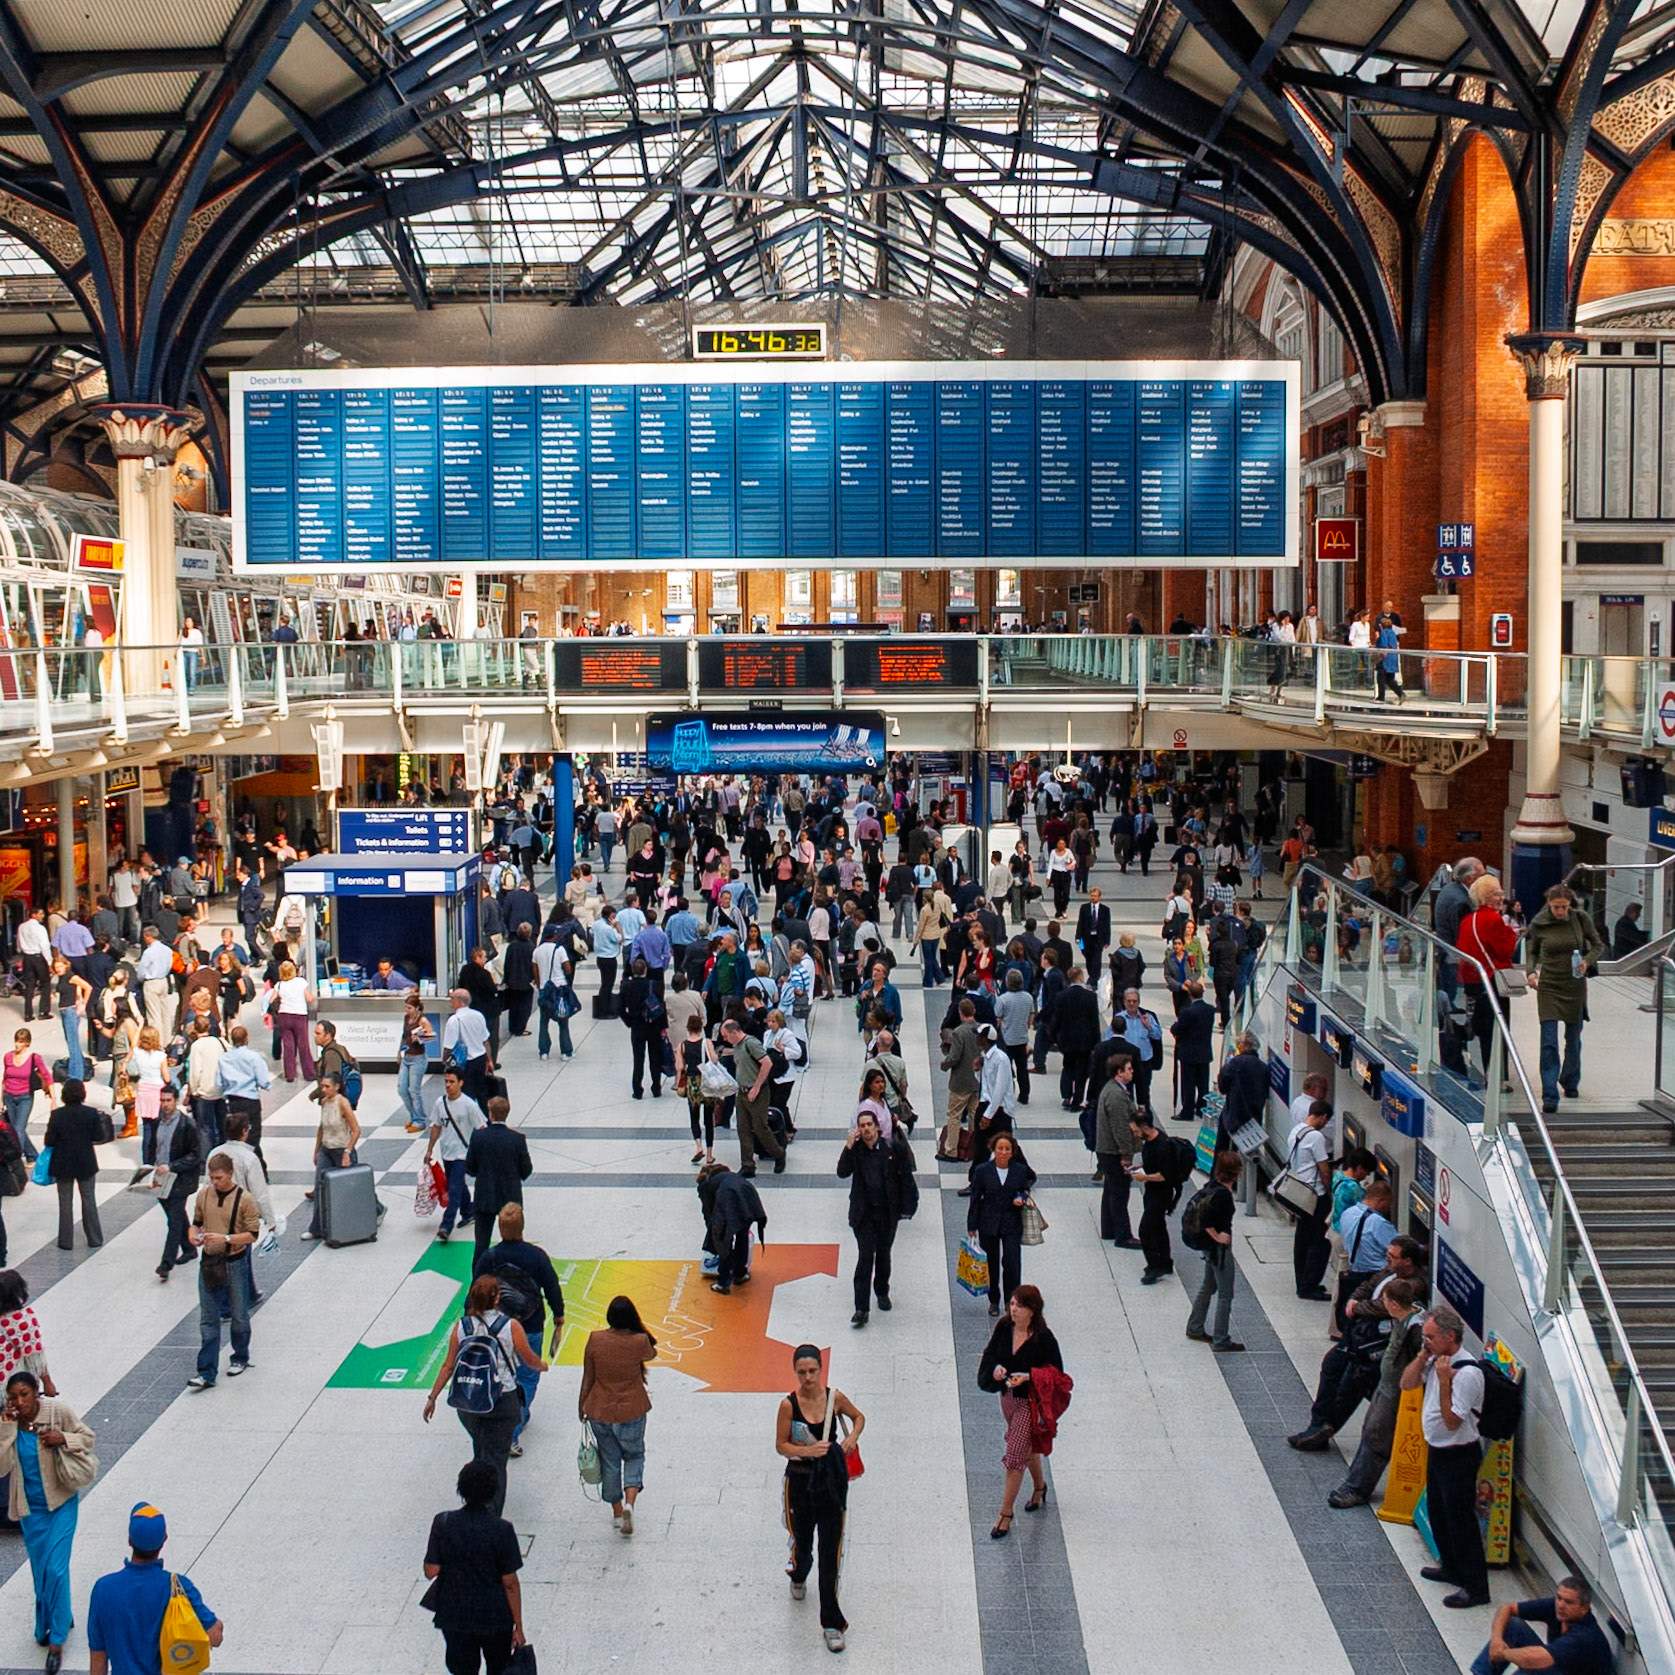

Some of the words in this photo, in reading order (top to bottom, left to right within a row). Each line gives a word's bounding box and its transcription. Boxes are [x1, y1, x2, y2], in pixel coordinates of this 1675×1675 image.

[250, 376, 302, 386] Departures
[712, 722, 728, 730] Free
[730, 722, 748, 730] texts
[749, 723, 774, 732] 7-8pm
[775, 722, 795, 730] when
[797, 724, 811, 732] you
[812, 722, 827, 731] join
[415, 813, 428, 822] Lift
[404, 826, 429, 834] Toilets
[355, 838, 380, 846] Tickets
[381, 838, 388, 846] &
[388, 838, 429, 846] Information
[338, 877, 384, 885] Information
